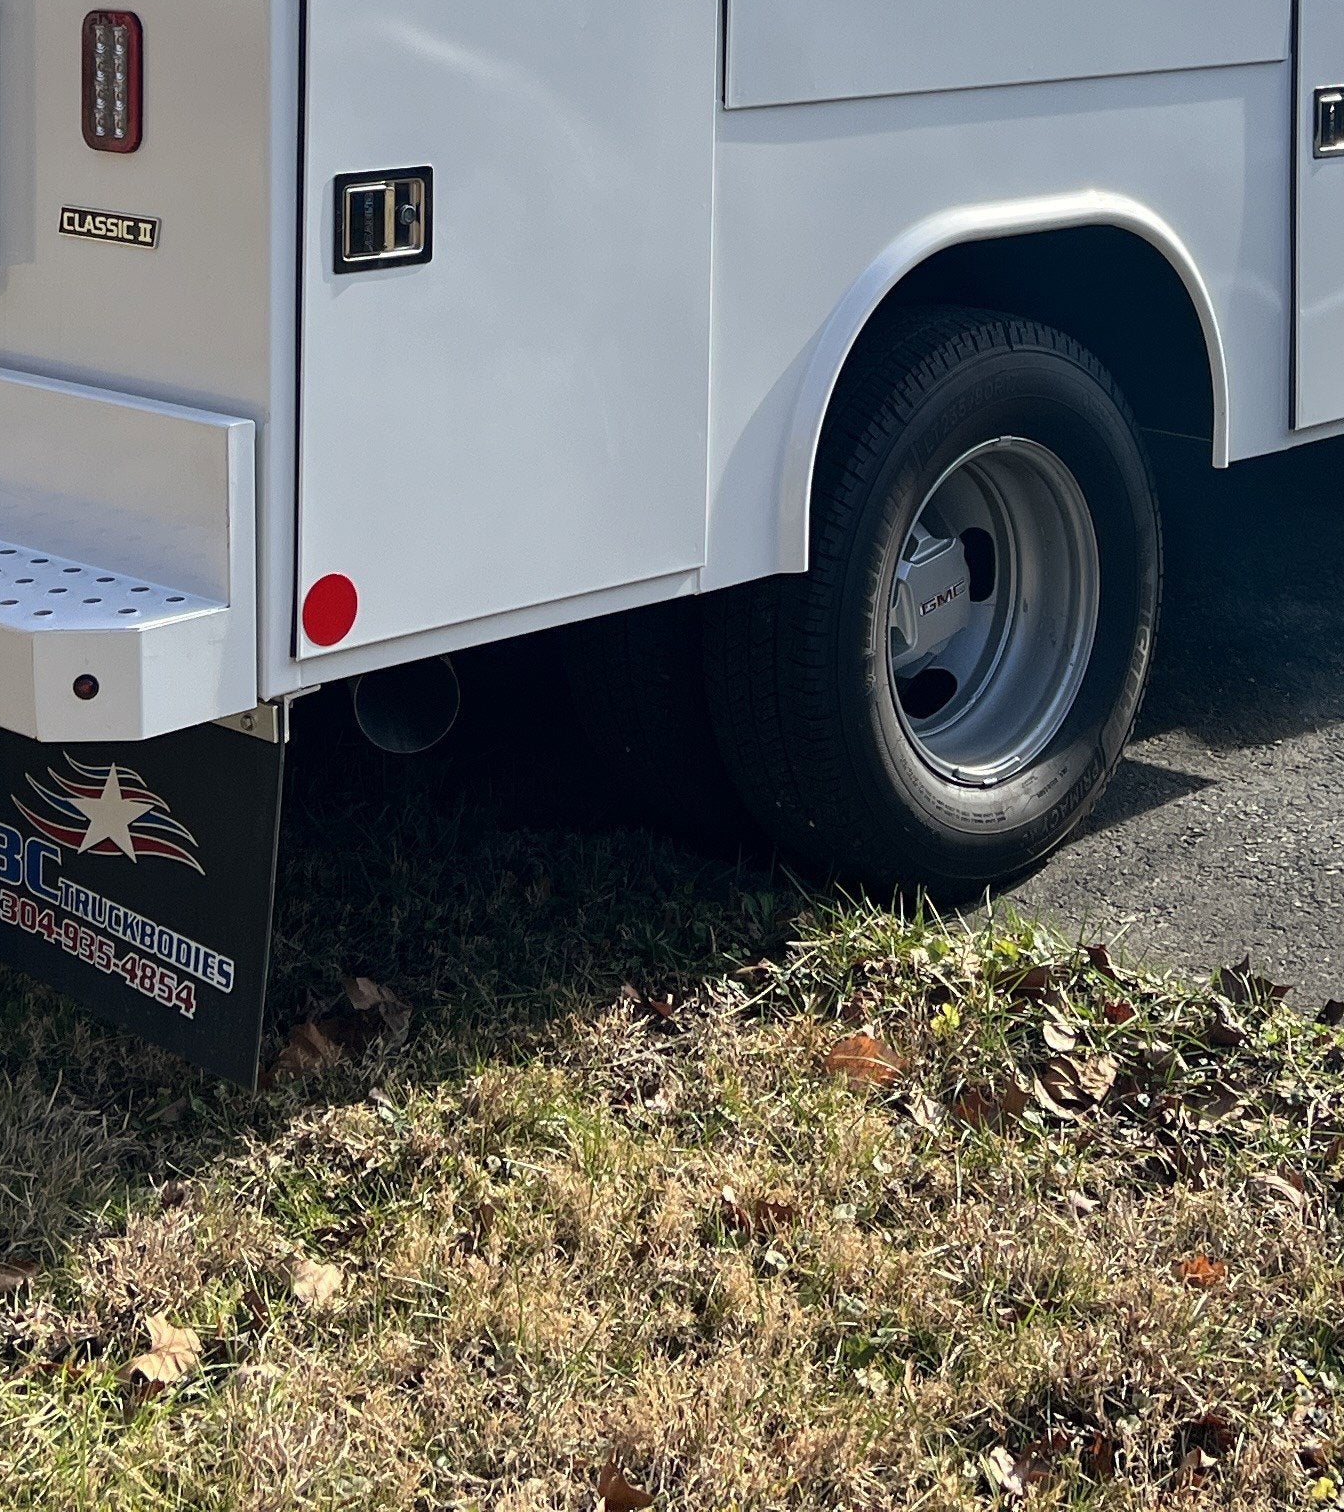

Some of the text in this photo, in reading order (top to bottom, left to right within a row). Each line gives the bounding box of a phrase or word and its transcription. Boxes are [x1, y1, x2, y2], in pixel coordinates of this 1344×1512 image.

[62, 211, 154, 244] CLASSIC II
[919, 577, 966, 617] GMC
[0, 888, 197, 1020] 304-935-4854
